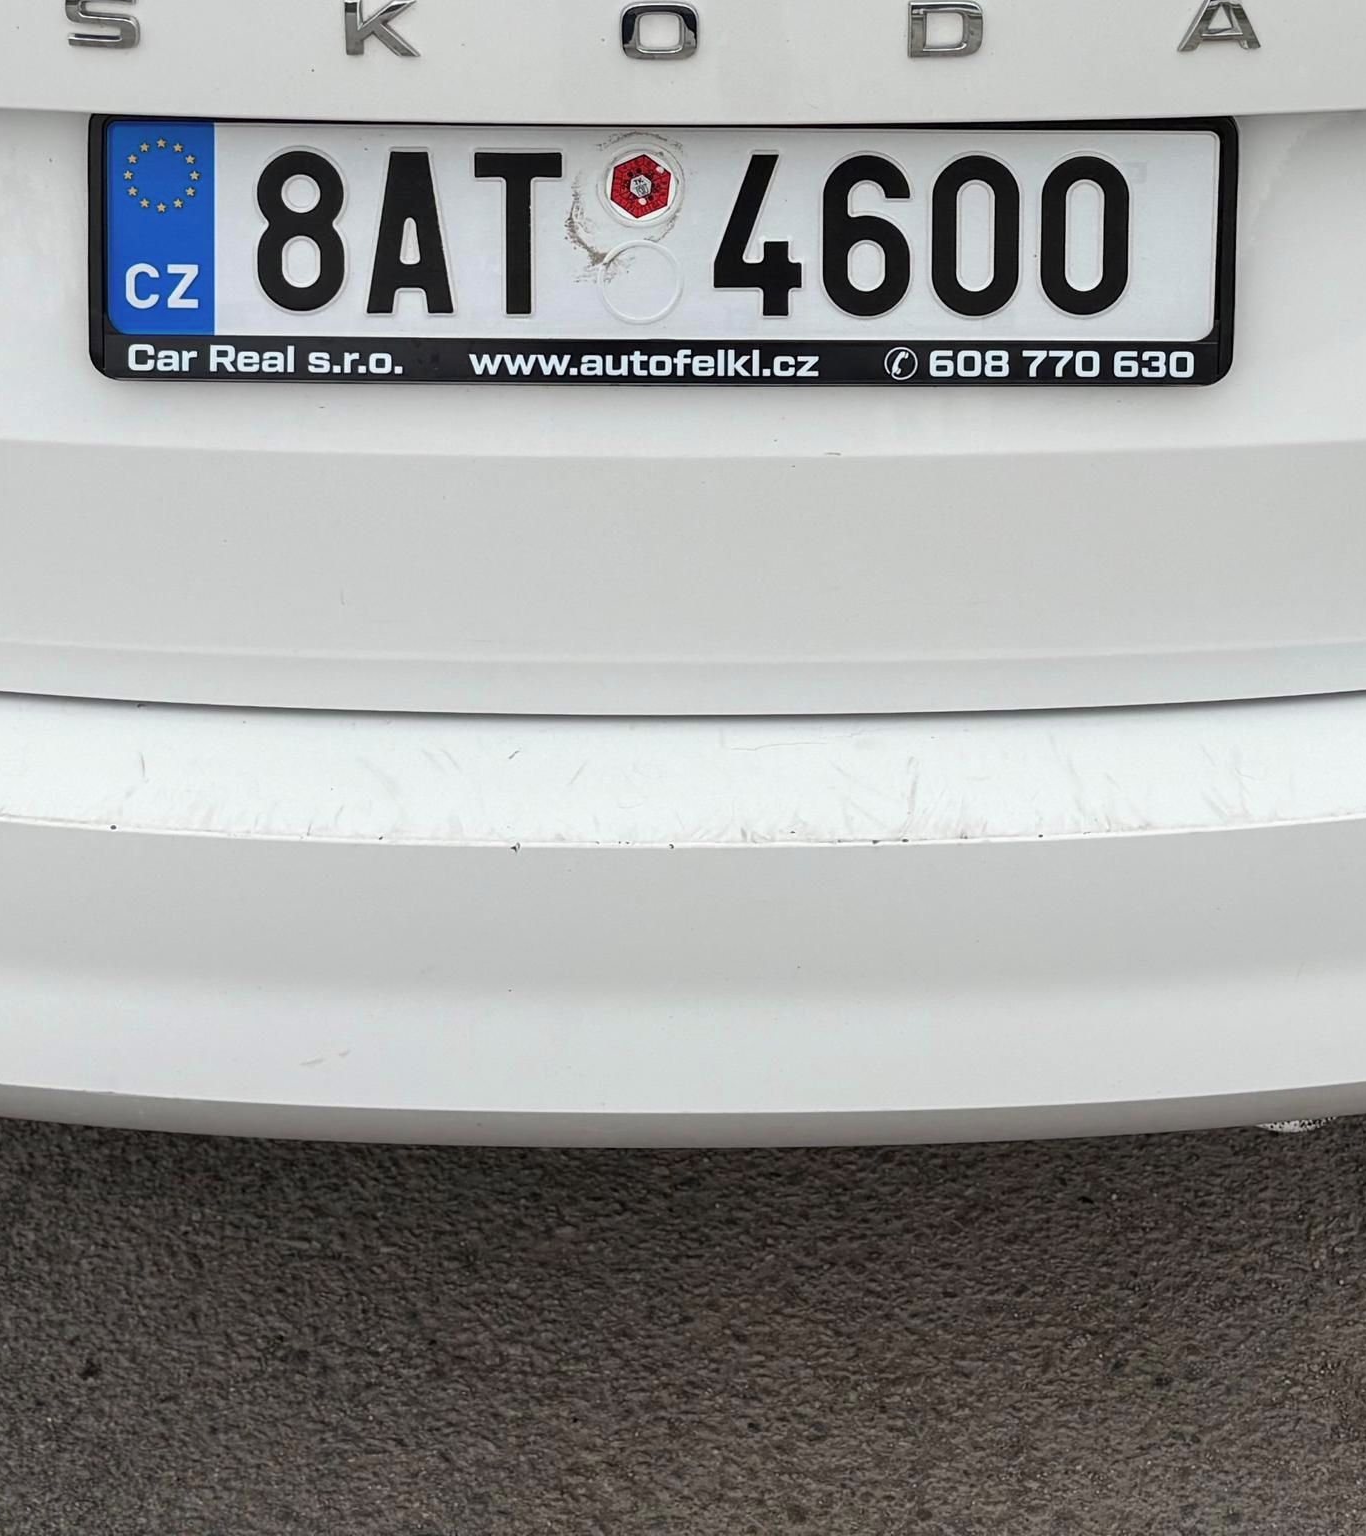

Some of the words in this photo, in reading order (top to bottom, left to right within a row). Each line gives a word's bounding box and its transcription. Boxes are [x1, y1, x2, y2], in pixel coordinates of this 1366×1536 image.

[256, 150, 563, 315] 8AT
[713, 154, 1130, 317] 4600
[124, 262, 200, 310] CZ
[127, 343, 197, 373] Car
[208, 343, 295, 374] Real
[307, 350, 404, 376] s.r.o.
[469, 348, 820, 378] www.autofelkl.cz
[928, 350, 1010, 379] 608
[1021, 350, 1101, 379] 770
[1113, 350, 1195, 379] 630
